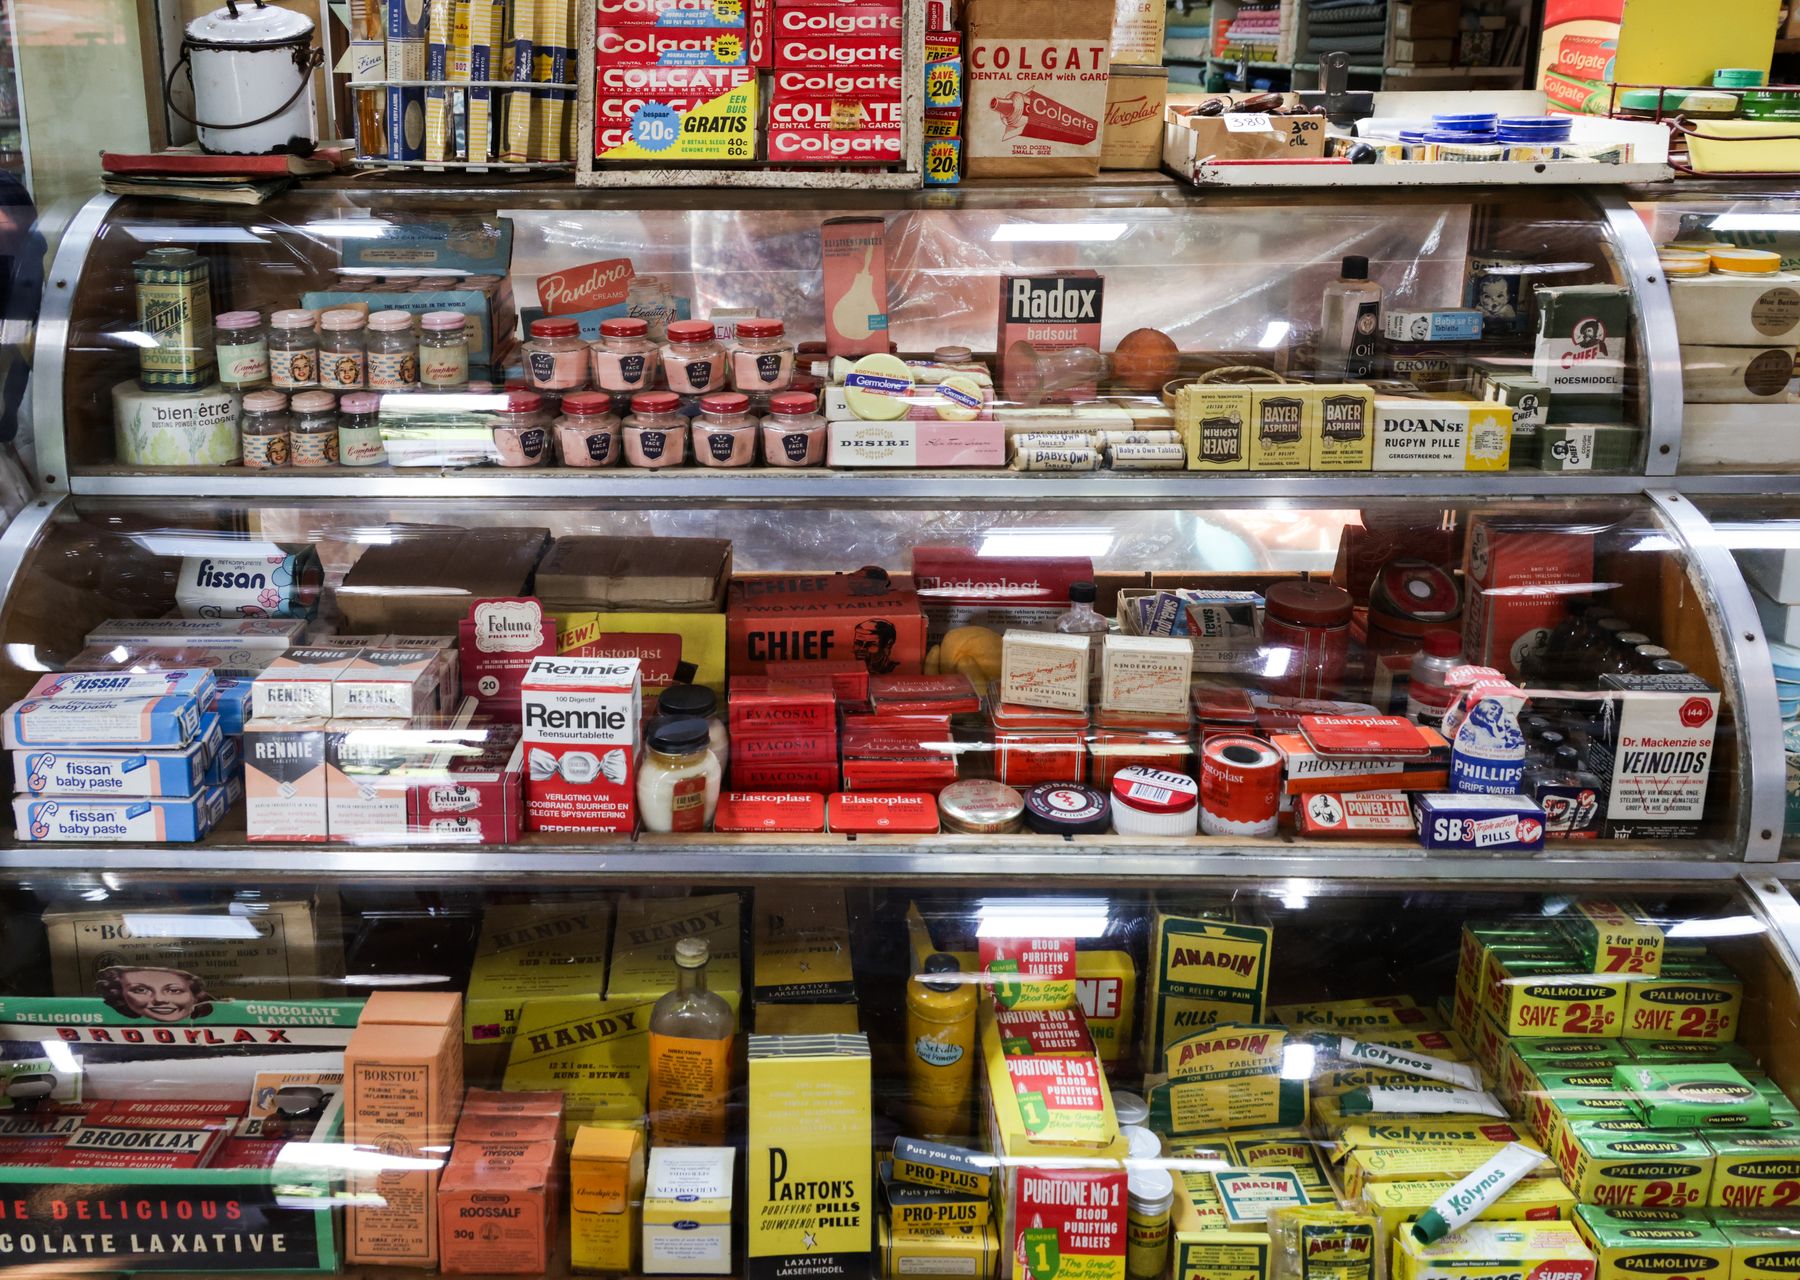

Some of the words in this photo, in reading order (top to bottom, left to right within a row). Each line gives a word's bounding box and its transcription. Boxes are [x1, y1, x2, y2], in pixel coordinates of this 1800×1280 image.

[926, 35, 957, 43] COLGATE
[1559, 49, 1605, 70] Colgate
[603, 69, 749, 88] COLGATE
[931, 70, 954, 80] SAVE
[971, 72, 1012, 81] DENTAL
[1016, 72, 1053, 81] CREAM
[1056, 72, 1076, 81] with
[931, 80, 957, 97] 20c
[729, 95, 748, 104] EEN
[643, 110, 670, 120] bespaar
[726, 105, 747, 114] BUIS
[1033, 98, 1094, 132] Colgate
[684, 116, 748, 133] GRATIS
[1232, 117, 1266, 128] 380
[638, 120, 674, 141] 20c
[926, 125, 952, 135] FREE
[727, 138, 748, 146] 40c
[775, 132, 900, 154] Colgate
[727, 147, 748, 156] 60c
[931, 147, 953, 157] SAVE
[931, 157, 956, 173] 20c
[539, 262, 632, 313] Pandora
[592, 291, 624, 301] CREAMS
[1011, 279, 1097, 318] Radox
[1027, 327, 1079, 341] badsout
[1355, 343, 1375, 357] Oil
[143, 355, 191, 364] POWDER
[856, 375, 902, 390] Germolene
[1554, 376, 1618, 385] HOESMIDDEL
[1264, 407, 1298, 422] BAYER
[1326, 405, 1361, 420] BAYER
[198, 414, 235, 427] COLOGNE
[1326, 422, 1361, 431] ASPIRIN
[1264, 423, 1298, 433] ASPIRIN
[840, 439, 910, 447] DESIRE
[1385, 438, 1426, 448] RUGPYN
[1432, 438, 1460, 448] PILLE
[196, 559, 266, 589] fissan
[836, 600, 904, 610] TABLETS
[488, 614, 532, 633] Feluna
[556, 623, 596, 650] NEW!
[747, 630, 834, 661] CHIEF
[291, 650, 347, 659] RENNIE
[369, 652, 426, 660] RENNIE
[581, 646, 662, 661] Elastoplast
[531, 661, 631, 675] Rennie
[482, 681, 496, 690] 20
[569, 695, 596, 704] Digestif
[526, 702, 627, 730] Rennie
[1687, 708, 1704, 717] 144
[1313, 716, 1401, 727] Elastoplast
[538, 729, 615, 740] Teensuurtablette
[1622, 737, 1638, 747] Dr.
[1641, 737, 1697, 747] Mackenzie
[1698, 738, 1712, 747] se
[255, 743, 312, 759] RENNIE
[66, 762, 111, 775] fissan
[1622, 751, 1707, 774] VEINOIDS
[56, 776, 87, 790] baby
[89, 777, 124, 790] paste
[1136, 767, 1193, 786] Mum
[1459, 781, 1484, 793] GRIPE
[1486, 785, 1515, 795] WATER
[434, 792, 472, 803] Feluna
[545, 793, 591, 802] VERLIGTING
[592, 794, 610, 802] VAN
[730, 793, 812, 804] Elastoplast
[841, 795, 923, 806] Elastoplast
[1355, 793, 1393, 801] PARTON'S
[576, 801, 617, 810] SUURHEID
[618, 802, 629, 810] EN
[1349, 801, 1407, 817] POWER-LAX
[70, 810, 115, 823] fissan
[529, 808, 560, 817] SLEGTE
[561, 809, 626, 819] SPYSVERTERING
[59, 823, 91, 836] baby
[93, 823, 127, 836] paste
[1434, 818, 1475, 842] SB3
[1496, 819, 1518, 829] action
[1481, 831, 1511, 843] PILLS
[1031, 939, 1060, 950] BLOOD
[1606, 935, 1613, 945] 2
[1615, 934, 1634, 945] for
[1637, 936, 1661, 948] only
[1022, 951, 1069, 963] PURIFYING
[1171, 946, 1257, 977] ANADIN
[1028, 963, 1064, 975] TABLETS
[1169, 984, 1185, 994] FOR
[1189, 986, 1215, 996] RELIEF
[1218, 989, 1228, 997] OF
[1232, 991, 1250, 1000] PAIN
[1533, 986, 1607, 998] PALMOLIVE
[1650, 990, 1726, 1002] PALMOLIVE
[16, 1013, 104, 1023] DELICIOUS
[246, 1004, 341, 1018] CHOCOLATE
[1296, 1009, 1390, 1026] Kolynos
[1518, 1004, 1560, 1027] SAVE
[257, 1015, 336, 1026] LAXATIVE
[1174, 1010, 1218, 1027] KILLS
[1634, 1008, 1675, 1030] SAVE
[56, 1026, 292, 1045] BROOKLAX
[528, 1011, 638, 1054] HANDY
[1179, 1034, 1270, 1067] ANADIN
[1351, 1042, 1433, 1071] Kolynos
[1067, 1060, 1084, 1076] No
[1085, 1061, 1096, 1077] 1
[1176, 1064, 1215, 1076] TABLETS
[76, 1130, 200, 1149] BROOKLAX
[1368, 1124, 1477, 1142] Kolynos
[1613, 1143, 1680, 1152] PALMOLIVE
[768, 1147, 855, 1202] PARTON'S
[904, 1162, 979, 1189] PRO-PLUS
[1610, 1165, 1691, 1176] PALMOLIVE
[1023, 1177, 1088, 1207] PURITONE
[1090, 1184, 1110, 1206] No
[1110, 1183, 1120, 1206] 1
[1231, 1181, 1288, 1193] ANADIN
[1449, 1168, 1507, 1217] Kolynos
[1593, 1184, 1638, 1206] SAVE
[53, 1200, 242, 1220] DELICIOUS
[459, 1207, 522, 1219] ROOSSALF
[761, 1203, 812, 1217] PURIFYING
[815, 1202, 861, 1214] PILLS
[903, 1205, 977, 1222] PRO-PLUS
[1075, 1207, 1109, 1221] BLOOD
[760, 1217, 816, 1231] SUIWERENDE
[818, 1216, 861, 1228] PILLE
[1063, 1221, 1118, 1235] PURIFYING
[453, 1229, 475, 1240] 30g
[1070, 1234, 1111, 1249] TABLETS
[131, 1233, 287, 1253] LAXATIVE
[784, 1257, 834, 1267] LAXATIVE
[1624, 1258, 1709, 1269] PALMOLIVE
[776, 1265, 844, 1277] LAKSEERMIDDEL
